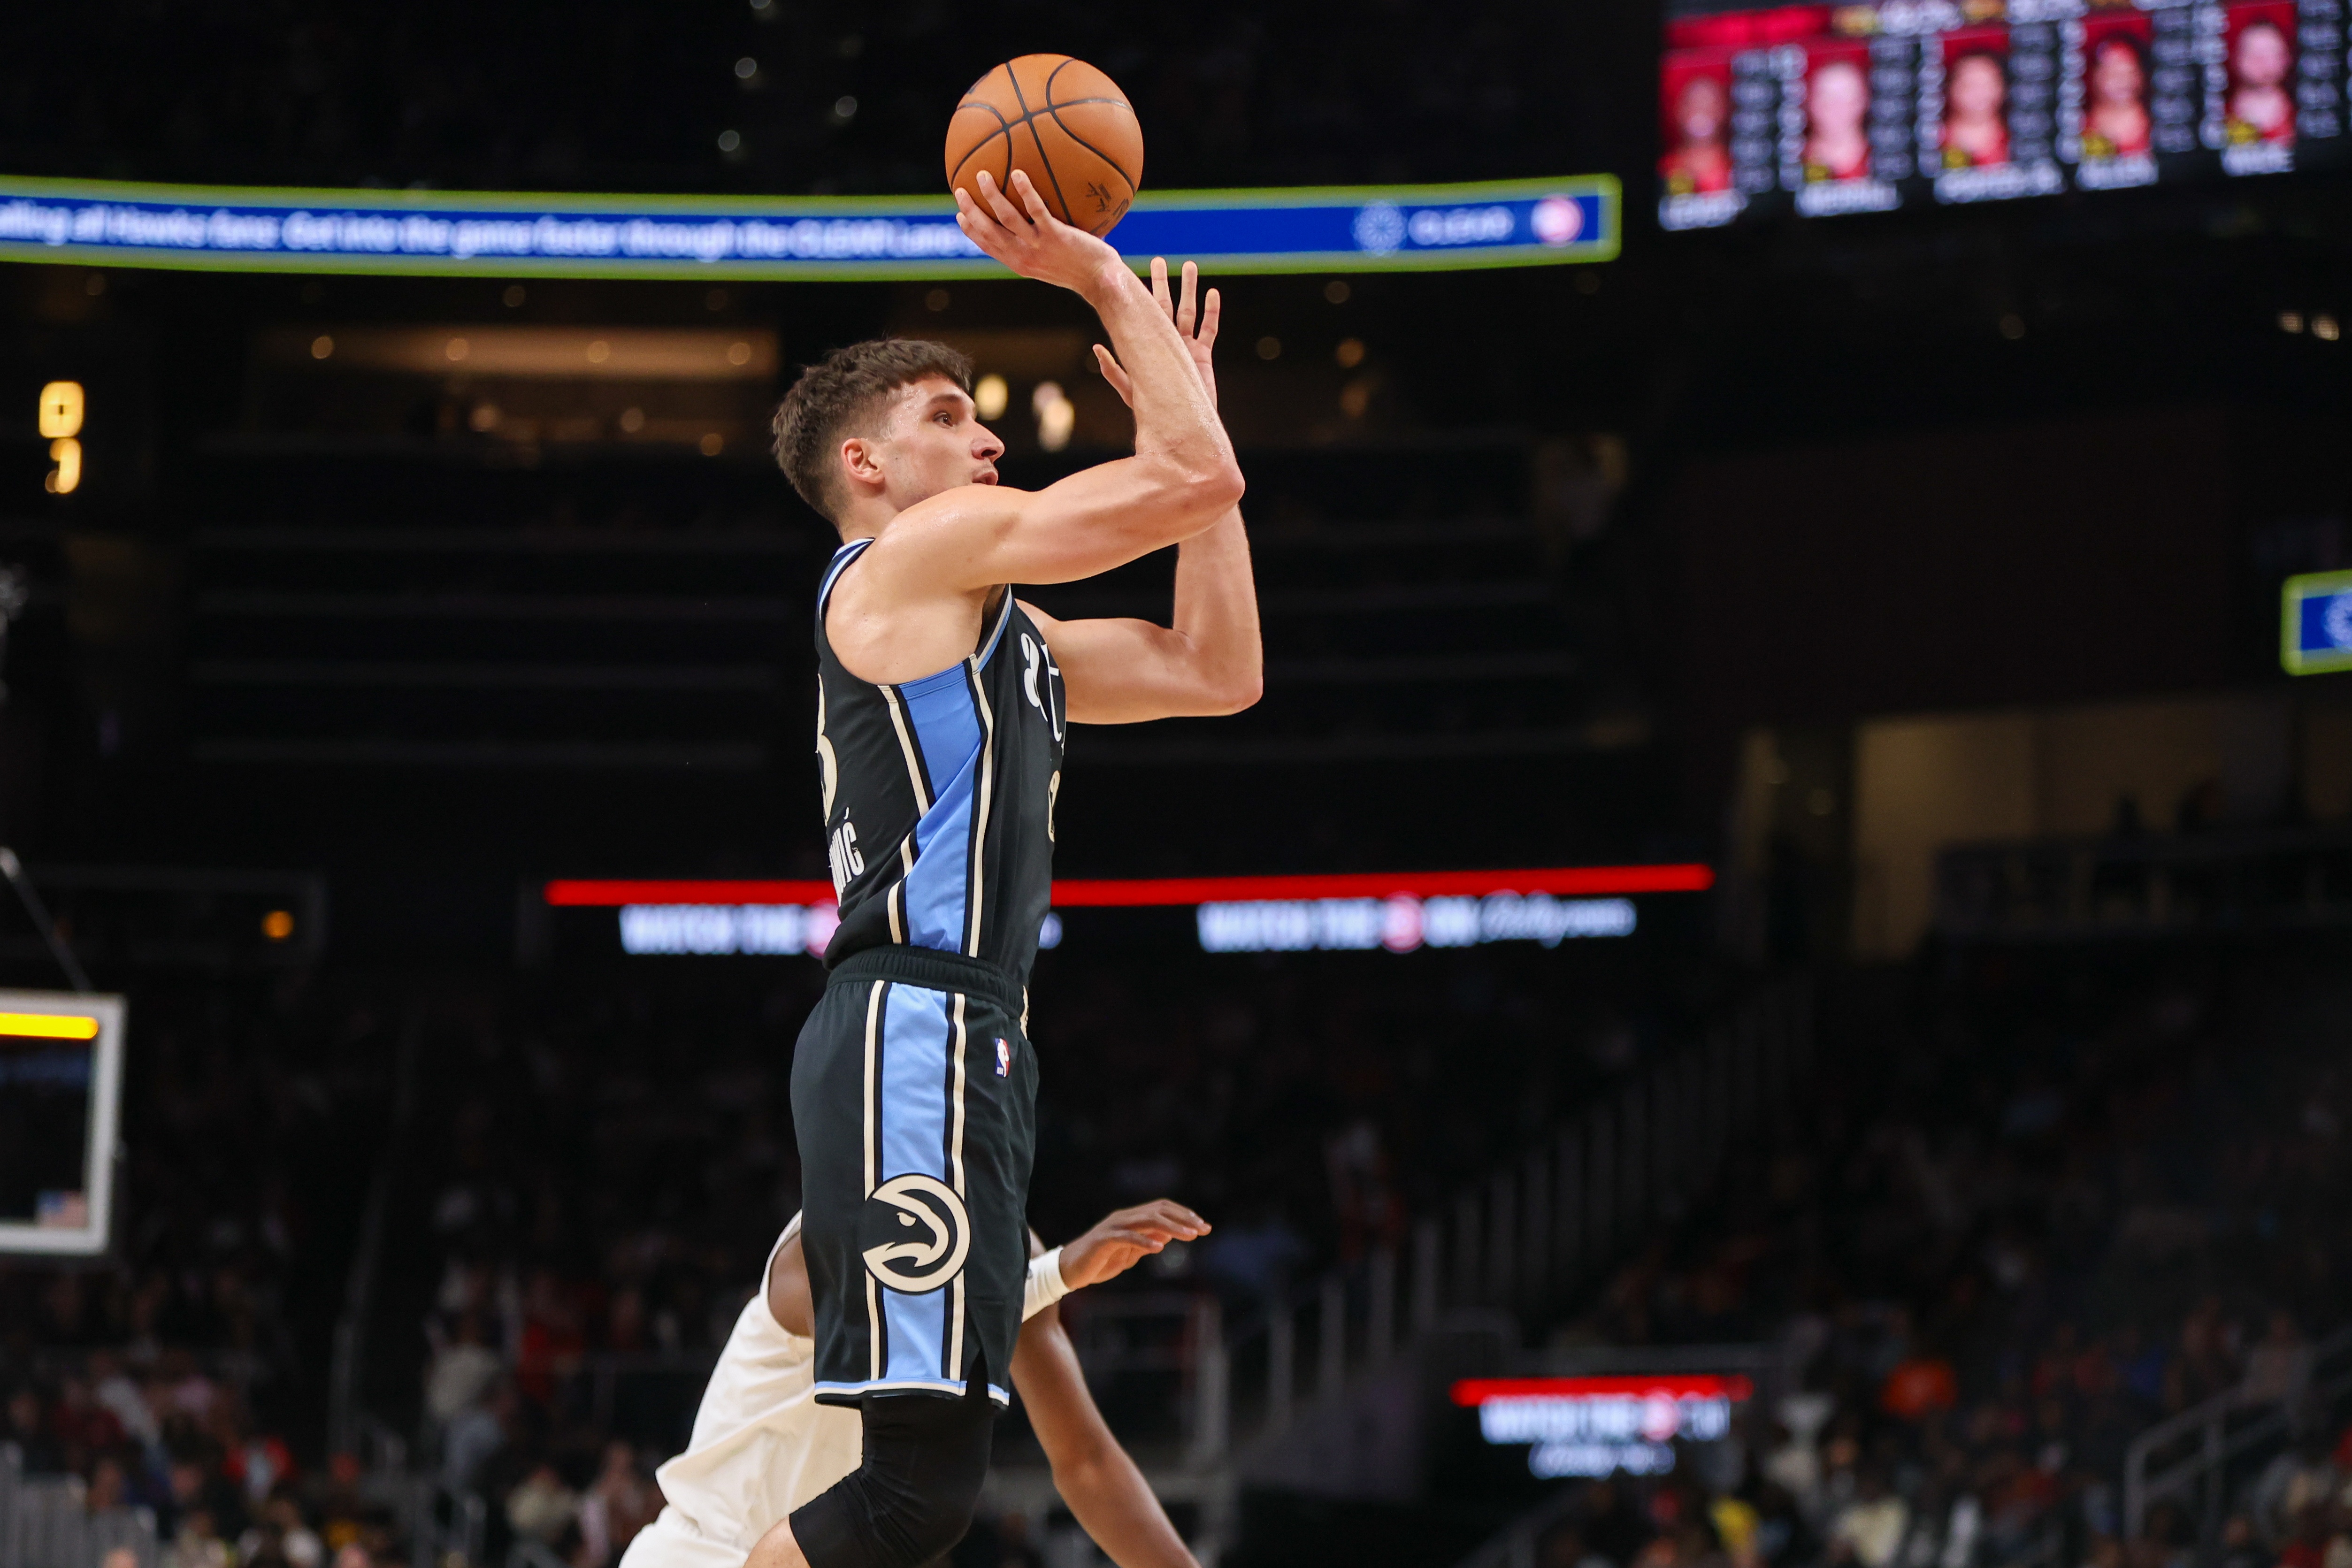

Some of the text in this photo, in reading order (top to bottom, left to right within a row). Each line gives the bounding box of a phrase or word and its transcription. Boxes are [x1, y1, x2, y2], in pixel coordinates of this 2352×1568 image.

[1409, 206, 1514, 245] CLEAR
[620, 903, 739, 955] WATCH
[1197, 898, 1314, 952] WATCH
